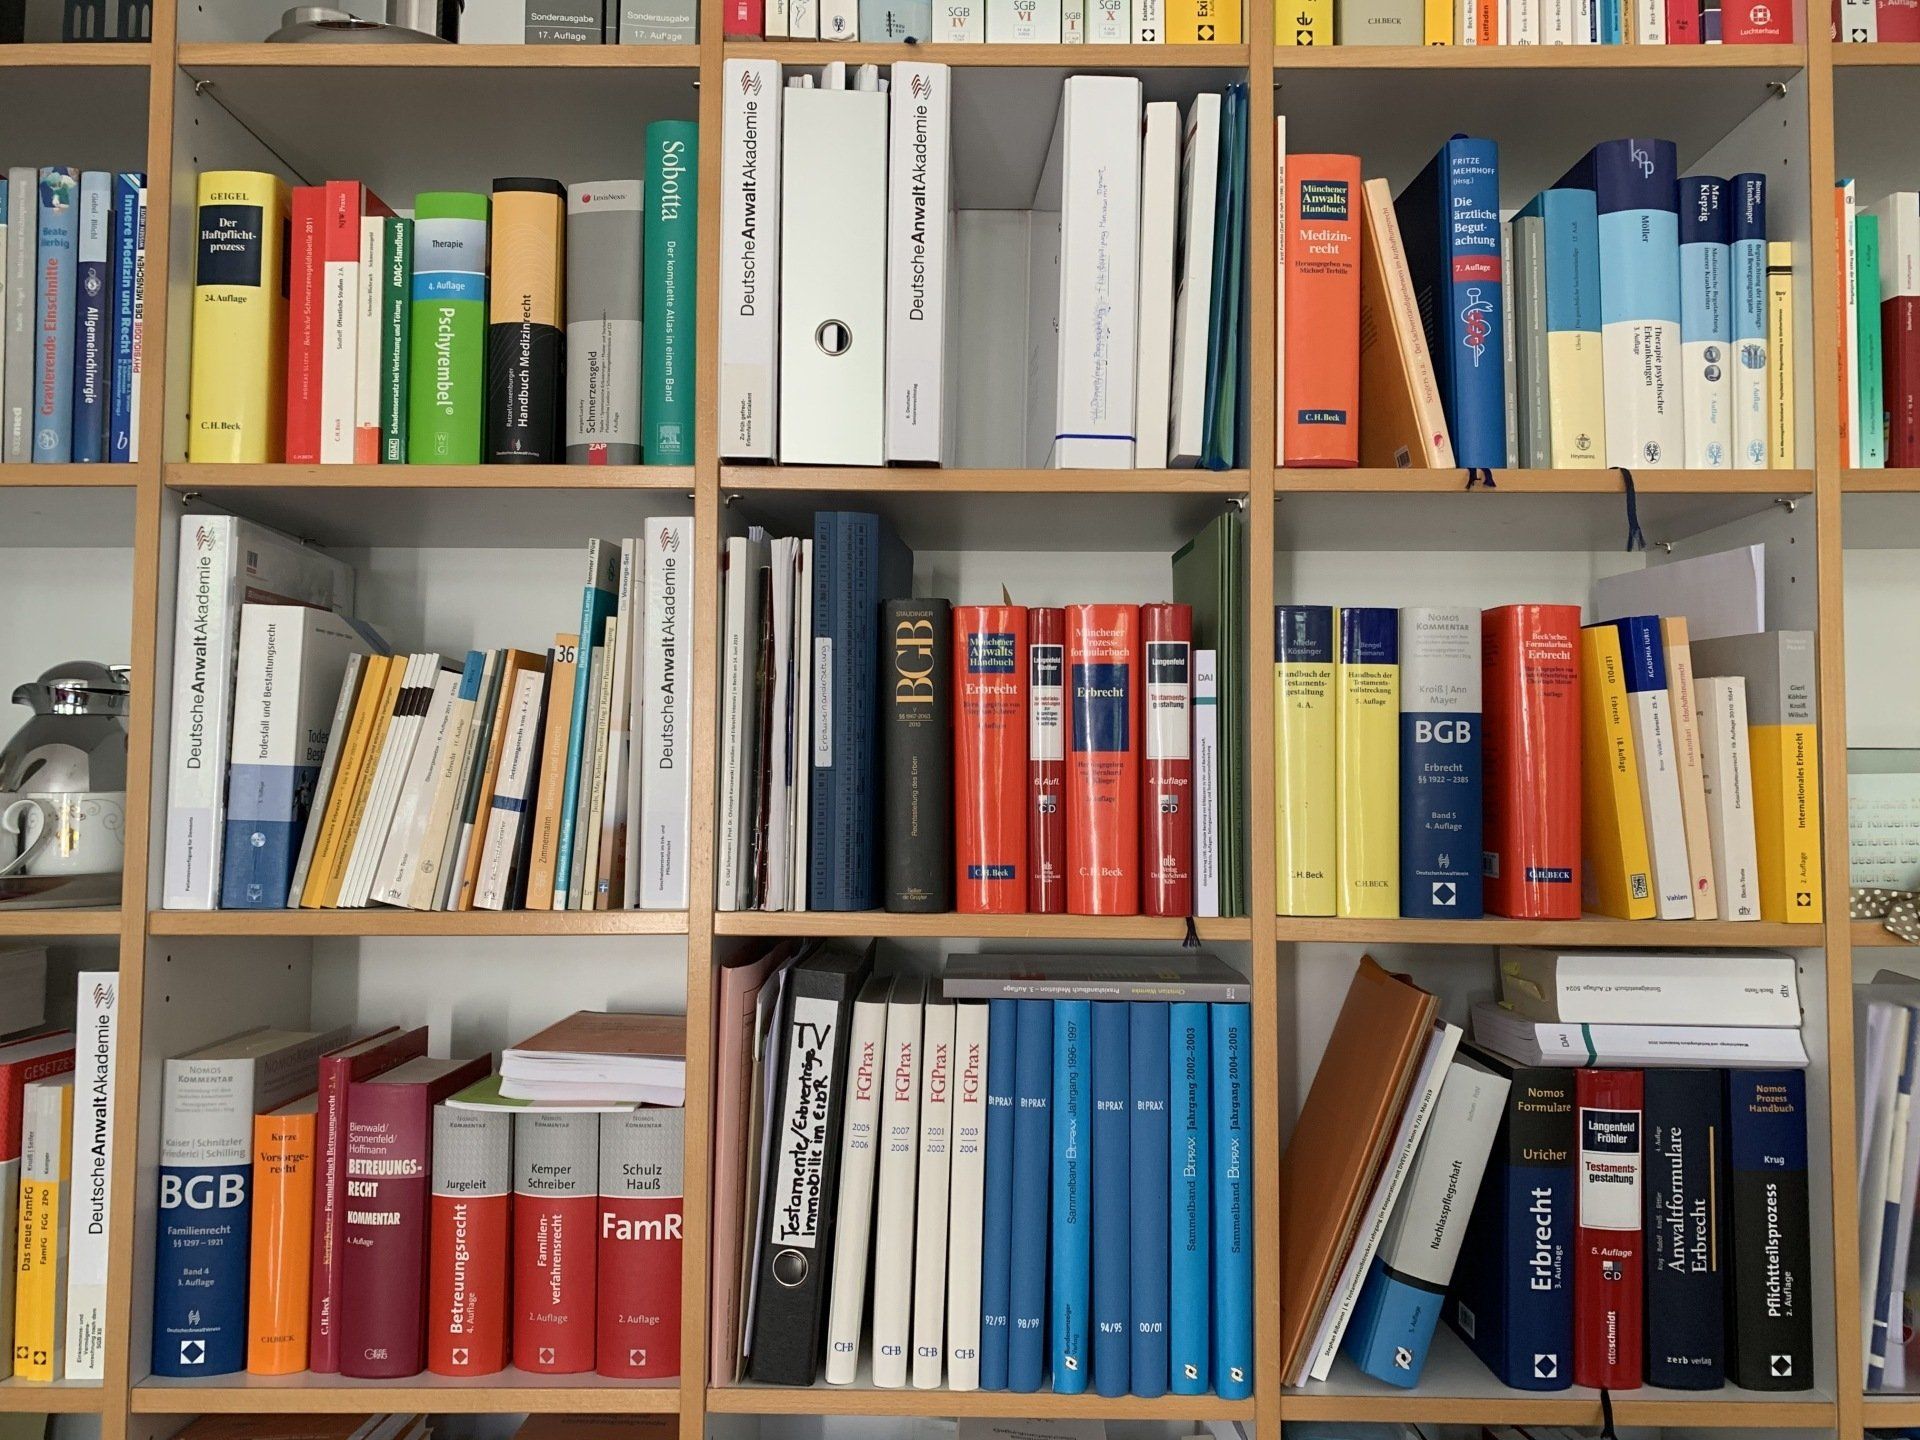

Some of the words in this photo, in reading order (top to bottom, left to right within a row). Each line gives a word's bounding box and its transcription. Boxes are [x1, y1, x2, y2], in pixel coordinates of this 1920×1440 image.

[1014, 0, 1036, 10] SGB
[1099, 0, 1121, 10] SGB
[627, 11, 690, 23] Sonderausgabe
[948, 7, 970, 16] SGB
[1018, 12, 1032, 21] VI
[1106, 11, 1115, 20] X
[531, 12, 594, 24] Sonderausgabe
[952, 18, 966, 27] IV
[538, 31, 550, 39] 17.
[554, 31, 586, 41] Auflage
[1453, 167, 1496, 175] MEHRHOFF
[662, 141, 686, 221] Sobotta
[210, 193, 249, 201] GEIGEL
[1711, 184, 1719, 209] Marx
[1754, 180, 1762, 204] Rompe
[1302, 193, 1345, 204] Anwalts
[1454, 197, 1472, 207] Die
[1698, 184, 1709, 222] Klepzig
[1746, 180, 1754, 223] Erlenkämper
[123, 194, 134, 235] Innere
[740, 101, 757, 316] DeutscheAnwaltAkademie
[910, 105, 927, 320] DeutscheAnwaltAkademie
[1302, 204, 1346, 213] Handbuch
[1454, 209, 1497, 220] ärztliche
[219, 218, 237, 227] Der
[1454, 223, 1487, 234] Begut-
[1641, 214, 1650, 243] Möller
[202, 230, 256, 242] Haftpflicht-
[1299, 229, 1351, 241] Medizin-
[1455, 235, 1495, 247] achtung
[210, 242, 246, 253] prozess
[432, 239, 463, 249] Therapie
[1309, 243, 1340, 254] recht
[393, 223, 404, 287] ADAC-Handbuch
[122, 238, 133, 288] Medizin
[437, 281, 465, 291] Auflage
[121, 290, 132, 315] und
[121, 318, 132, 354] Recht
[519, 294, 531, 367] Medizinrecht
[1653, 326, 1662, 363] Therapie
[83, 307, 98, 404] Allgemeinchirurgie
[1643, 326, 1653, 386] Erkrankungen
[586, 351, 599, 434] Schmerzensgeld
[1654, 365, 1664, 415] psychischer
[517, 370, 529, 427] Handbuch
[589, 443, 607, 451] ZAP
[1075, 628, 1124, 637] Mnchener
[1532, 632, 1567, 640] Beck'sches
[1643, 628, 1651, 645] IURIS
[556, 645, 574, 663] 36
[1287, 648, 1322, 656] Kössinger
[1528, 650, 1570, 660] Erbrecht
[187, 557, 211, 769] DeutscheAnwaltAkademie
[263, 623, 277, 697] Bestattungsrecht
[660, 558, 676, 769] DeutscheAnwaltAkademie
[895, 619, 934, 706] BGB
[1645, 645, 1655, 677] ACADEMIA
[966, 683, 1017, 694] Erbrecht
[1077, 687, 1124, 697] Erbrecht
[1286, 688, 1324, 697] gestaltung
[1430, 696, 1458, 705] Mayer
[261, 700, 271, 718] und
[1415, 720, 1471, 743] BGB
[258, 720, 270, 759] Todesfall
[1796, 733, 1804, 766] Erbrecht
[1424, 763, 1463, 772] Erbrecht
[1429, 775, 1445, 783] 1922
[1452, 775, 1469, 783] 2385
[1797, 767, 1806, 828] Internationales
[1425, 822, 1433, 830] 4.
[1434, 822, 1462, 832] Auflage
[538, 816, 552, 864] Zimmermann
[1666, 894, 1688, 902] Vahlen
[856, 1042, 874, 1101] FGPrax
[895, 1043, 912, 1102] FGPrax
[930, 1043, 947, 1104] FGPrax
[963, 1043, 979, 1103] FGPrax
[1528, 1088, 1565, 1098] Nomos
[1755, 1085, 1787, 1093] Nomos
[1756, 1094, 1788, 1104] Prozess
[1186, 1083, 1197, 1130] Jahrgang
[1517, 1102, 1571, 1113] Formulare
[1749, 1103, 1795, 1114] Handbuch
[88, 1014, 109, 1234] DeutscheAnwaltAkademie
[852, 1123, 870, 1132] 2005
[1588, 1121, 1635, 1133] Langenfeld
[892, 1127, 910, 1135] 2007
[165, 1138, 191, 1147] Kaiser
[197, 1137, 243, 1147] Schnitzler
[850, 1141, 869, 1149] 2006
[260, 1152, 309, 1165] Vorsorge-
[1523, 1149, 1567, 1161] Uricher
[270, 1164, 296, 1175] recht
[349, 1159, 422, 1176] BETREUUNGS-
[531, 1164, 571, 1175] Kemper
[623, 1164, 662, 1175] Schulz
[1585, 1162, 1638, 1173] Testaments-
[446, 1179, 486, 1190] Jurgeleit
[528, 1178, 575, 1190] Schreiber
[1589, 1173, 1634, 1185] gestaltung
[160, 1175, 245, 1209] BGB
[348, 1181, 379, 1198] RECHT
[24, 1186, 34, 1221] FamFG
[1430, 1160, 1462, 1250] Nachlasspflegschaft
[1665, 1126, 1685, 1274] Anwaltformulare
[347, 1210, 400, 1226] KOMMENTAR
[1187, 1181, 1196, 1251] Sammelband
[24, 1224, 32, 1249] neue
[167, 1225, 231, 1236] Familienrecht
[1690, 1198, 1707, 1273] Erbrecht
[537, 1214, 548, 1267] Familien-
[1530, 1187, 1552, 1290] Erbrecht
[1765, 1183, 1782, 1317] Pflichtteilsprozess
[22, 1252, 31, 1271] Das
[550, 1214, 562, 1304] verfahrensrecht
[450, 1203, 469, 1334] Betreuungsrecht
[467, 1292, 477, 1324] Auflage
[619, 1315, 626, 1323] 2.
[628, 1315, 660, 1325] Auflage
[985, 1315, 1006, 1326] 92/93
[1017, 1318, 1040, 1329] 98/99
[466, 1325, 474, 1333] 4.
[1100, 1322, 1122, 1333] 94/95
[1139, 1322, 1162, 1333] 00/01
